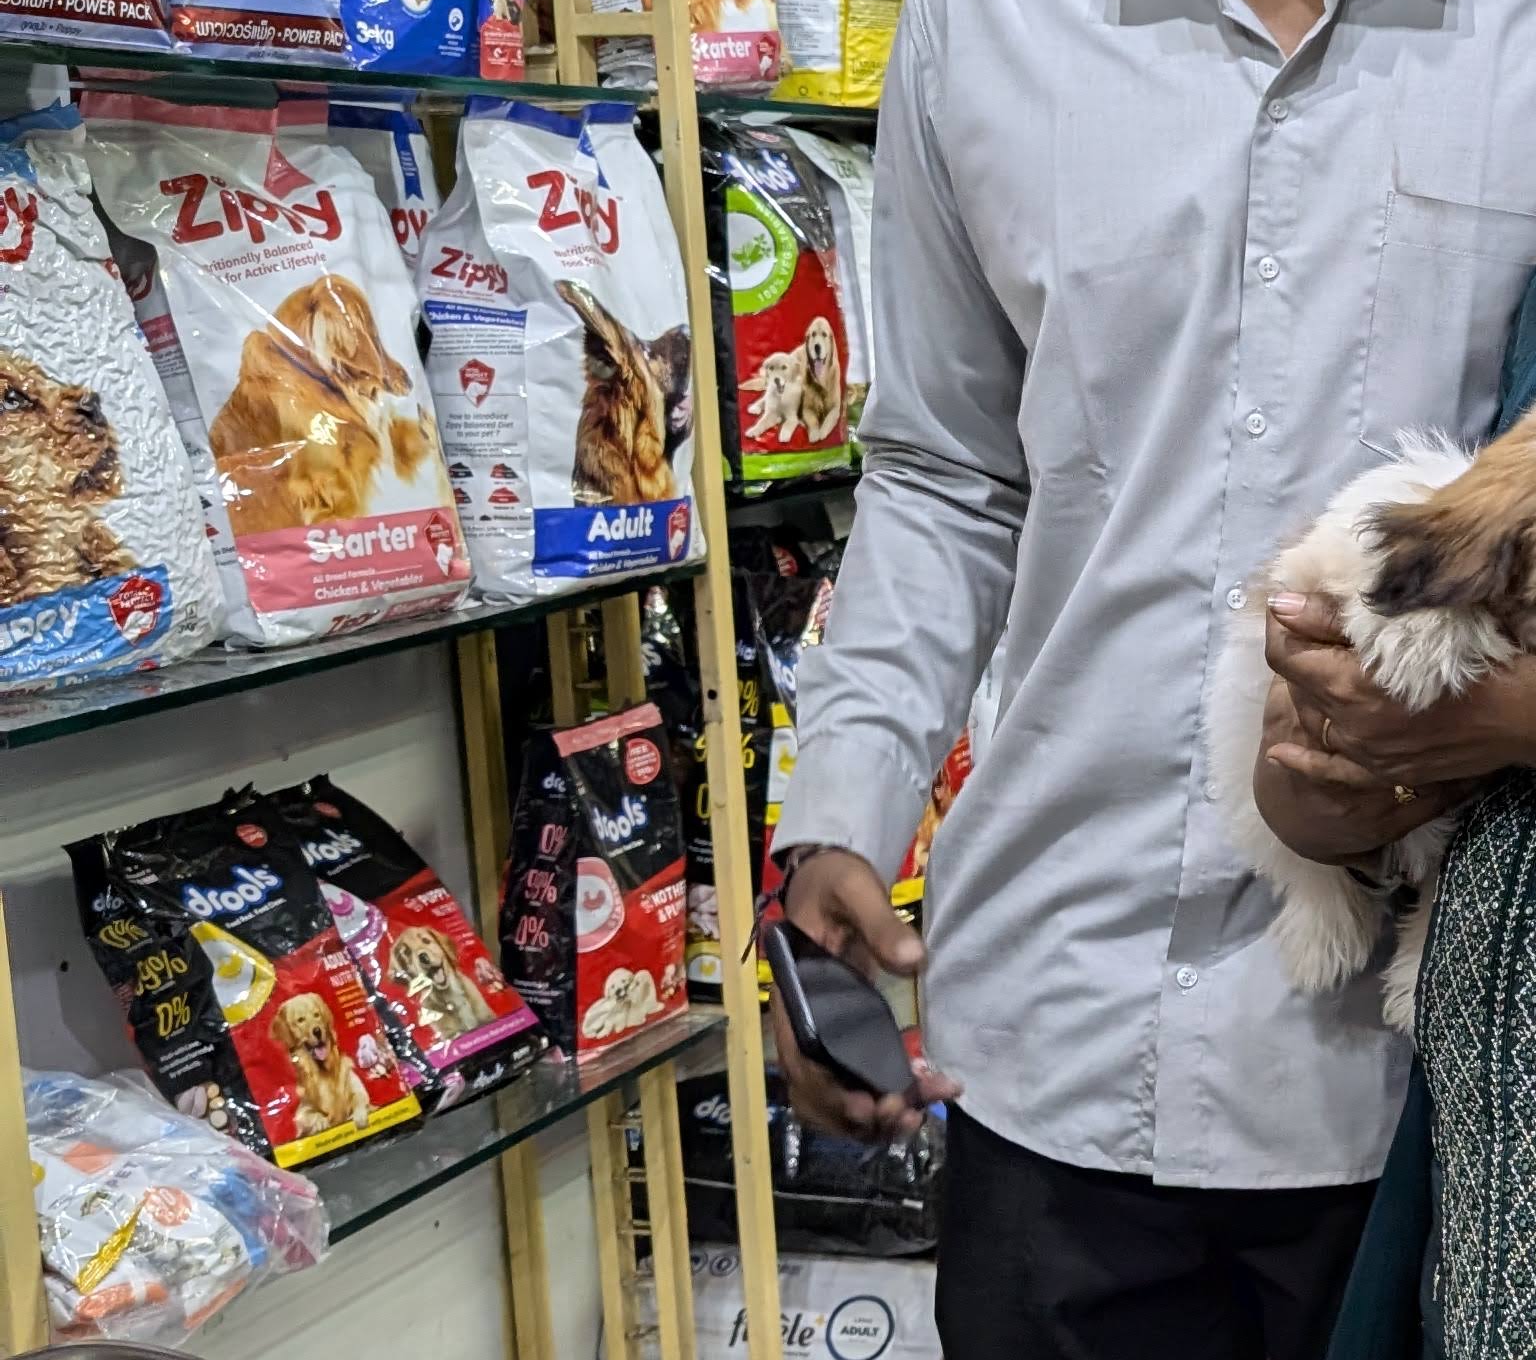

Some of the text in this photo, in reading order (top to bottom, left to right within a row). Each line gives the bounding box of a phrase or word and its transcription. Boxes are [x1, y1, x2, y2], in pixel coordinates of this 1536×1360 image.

[120, 0, 153, 21] PACK
[283, 28, 344, 48] POWER PAC
[264, 239, 315, 259] Balanced
[244, 261, 280, 282] Active
[280, 251, 328, 272] Lifestyle
[588, 506, 655, 543] Adult
[304, 522, 419, 564] Starter
[314, 583, 359, 600] Chicken
[360, 581, 369, 594] &
[186, 865, 280, 918] drools
[651, 878, 687, 906] MOTHE
[840, 1326, 881, 1338] ADULT
